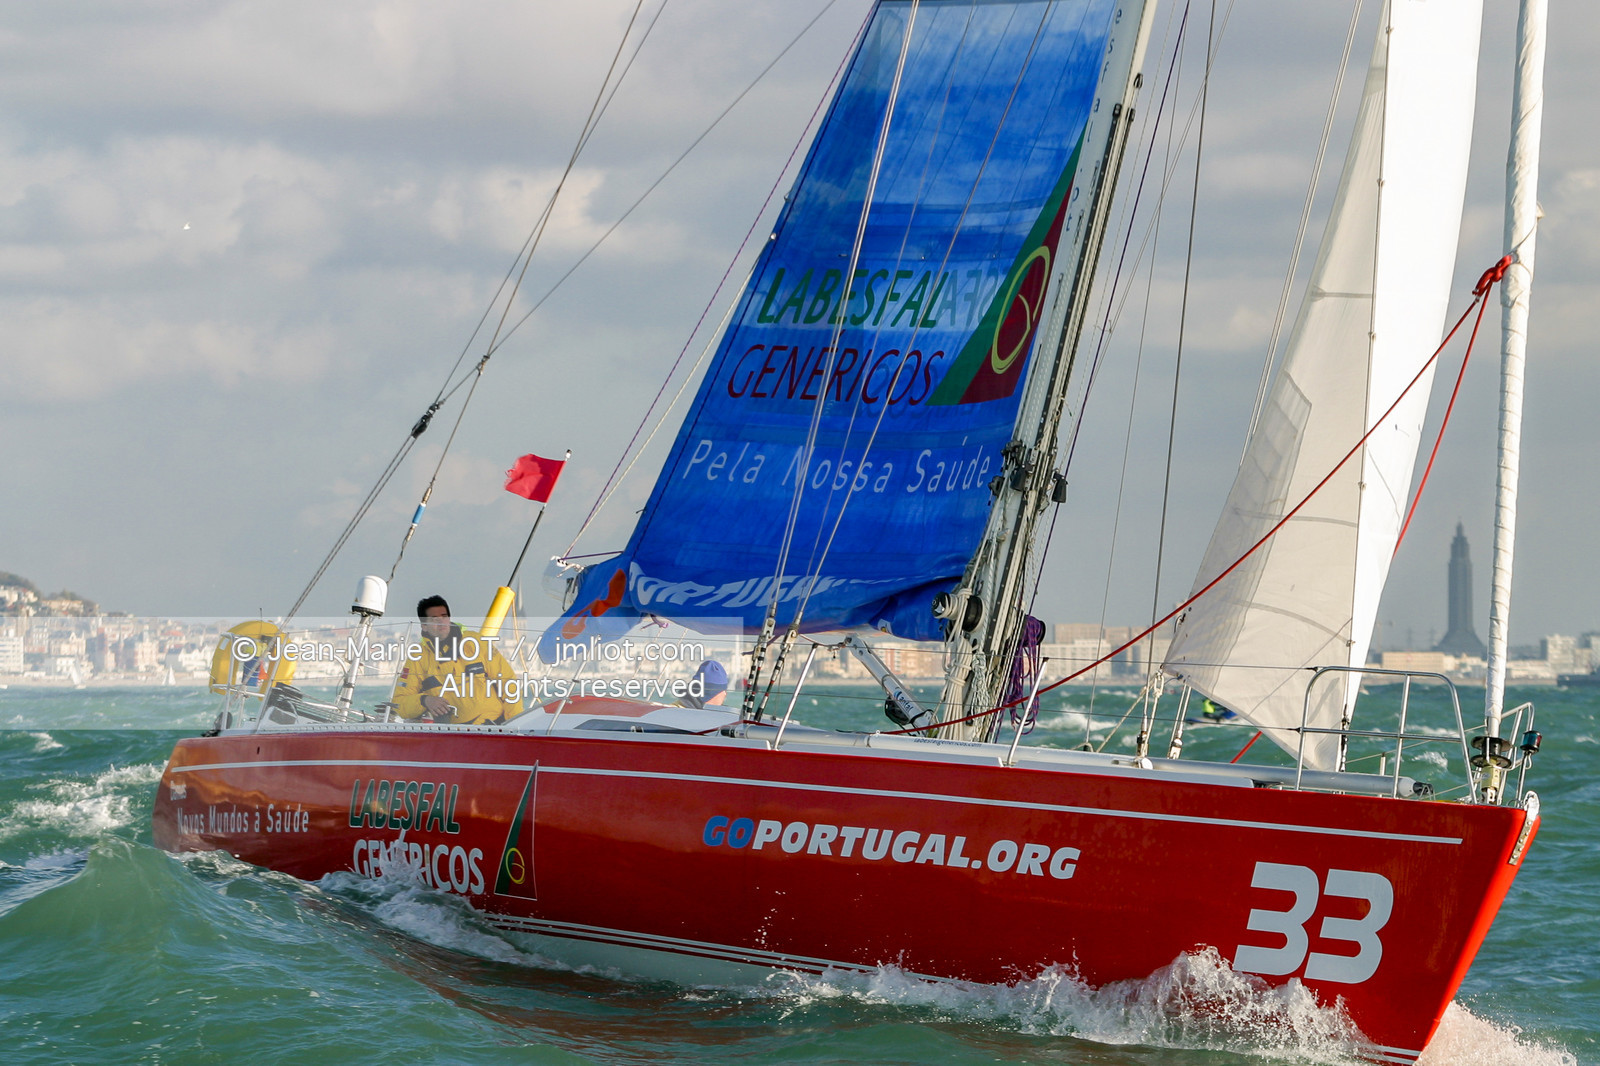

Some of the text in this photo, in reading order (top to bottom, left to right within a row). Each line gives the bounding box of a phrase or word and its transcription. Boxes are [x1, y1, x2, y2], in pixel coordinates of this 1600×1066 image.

[756, 267, 950, 328] LABESFAL
[727, 329, 944, 406] GENÉRICOS
[682, 436, 991, 493] Pela Nossa Saúde
[177, 807, 205, 835] Novos
[208, 804, 249, 833] Mundos
[266, 803, 309, 833] Saúde
[349, 778, 461, 835] LABESFAL
[702, 815, 1081, 880] GOPORTUGAL.ORG
[1232, 861, 1394, 984] 33
